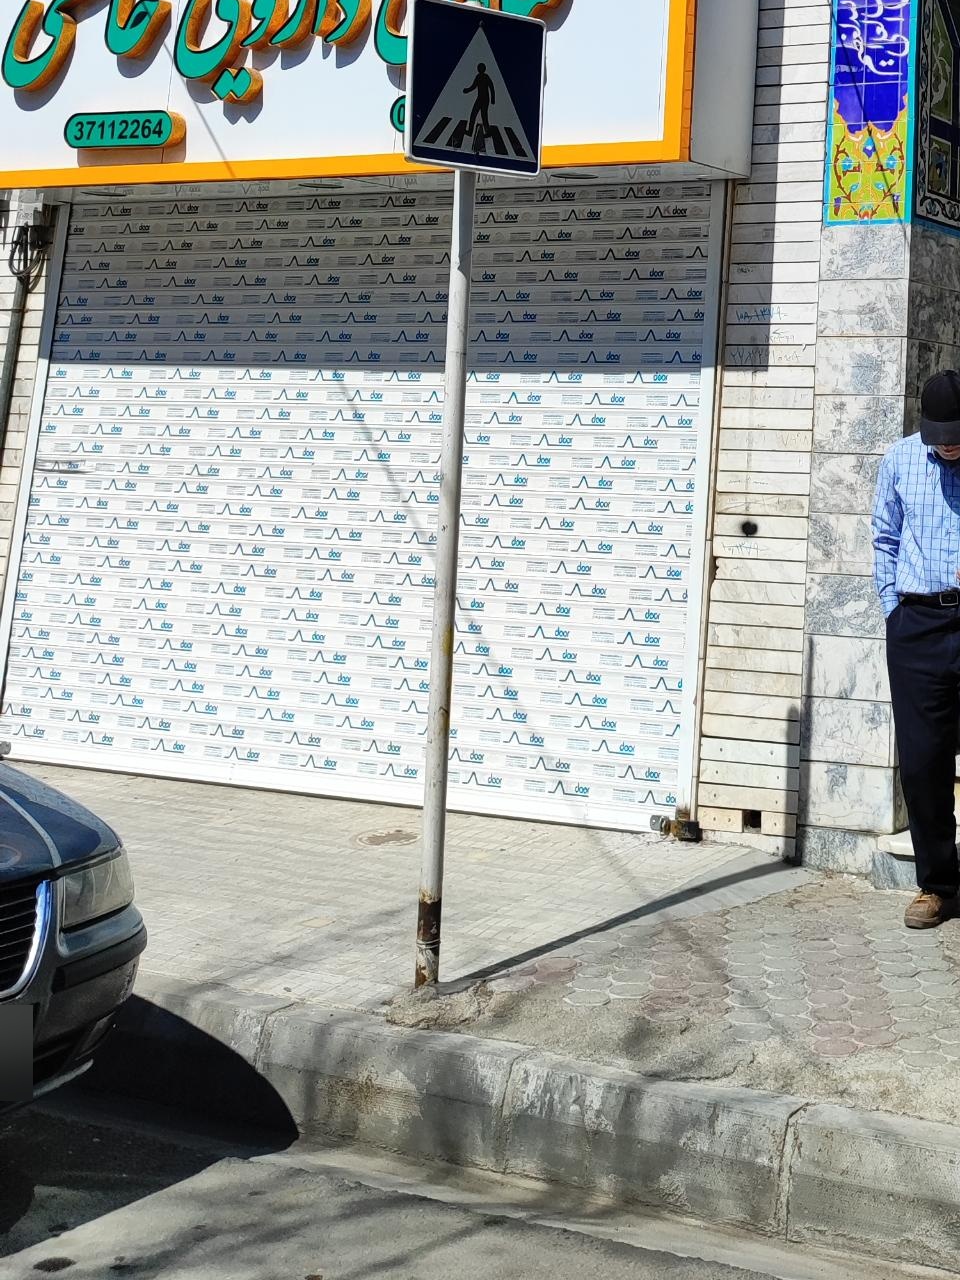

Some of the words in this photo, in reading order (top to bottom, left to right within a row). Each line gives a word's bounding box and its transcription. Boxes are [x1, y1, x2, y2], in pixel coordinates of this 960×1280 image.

[73, 117, 165, 142] 37112264
[328, 199, 341, 207] door
[425, 215, 439, 223] door
[138, 223, 150, 231] door
[254, 275, 267, 283] door
[327, 274, 340, 282] door
[564, 270, 578, 279] door
[212, 293, 225, 303] door
[289, 312, 303, 322] door
[496, 330, 511, 340] door
[155, 351, 167, 359] door
[605, 352, 621, 362] door
[407, 370, 422, 380] door
[224, 389, 236, 397] door
[295, 389, 309, 399] door
[370, 390, 384, 400] door
[72, 405, 83, 414] door
[138, 407, 150, 415] door
[429, 412, 442, 421] door
[507, 412, 522, 423] door
[592, 413, 607, 424] door
[323, 429, 335, 438] door
[643, 436, 658, 447] door
[93, 443, 104, 451] door
[160, 444, 171, 453] door
[230, 446, 242, 455] door
[377, 450, 391, 460] door
[538, 454, 552, 465] door
[281, 467, 294, 477] door
[57, 478, 68, 486] door
[598, 477, 613, 488] door
[346, 488, 360, 499] door
[427, 493, 440, 502] door
[97, 498, 108, 507] door
[167, 501, 180, 511] door
[509, 496, 524, 506] door
[240, 504, 252, 515] door
[59, 516, 70, 524] door
[560, 519, 574, 529] door
[648, 522, 664, 533] door
[350, 529, 362, 538] door
[598, 542, 612, 552] door
[51, 553, 62, 562] door
[120, 557, 131, 566] door
[409, 554, 422, 563] door
[190, 561, 202, 572] door
[490, 557, 505, 569] door
[265, 566, 277, 575] door
[341, 570, 354, 581] door
[667, 568, 682, 578] door
[591, 585, 607, 596] door
[470, 598, 485, 610] door
[21, 609, 33, 620] door
[305, 610, 319, 620] door
[556, 605, 570, 615] door
[90, 614, 102, 625] door
[386, 616, 399, 625] door
[645, 610, 661, 621] door
[161, 620, 174, 630] door
[235, 626, 248, 636] door
[562, 649, 577, 661] door
[414, 659, 428, 669] door
[653, 657, 669, 668] door
[49, 668, 61, 679] door
[498, 664, 513, 676] door
[119, 675, 132, 685] door
[338, 674, 351, 684] door
[192, 681, 204, 691] door
[267, 688, 280, 698] door
[21, 705, 32, 714] door
[513, 711, 527, 721] door
[361, 717, 376, 728] door
[602, 719, 617, 729] door
[102, 733, 114, 744] door
[173, 741, 185, 752] door
[247, 750, 260, 760] door
[323, 756, 337, 768] door
[405, 766, 418, 776] door
[645, 769, 661, 780] door
[488, 775, 502, 786] door
[575, 785, 589, 795] door
